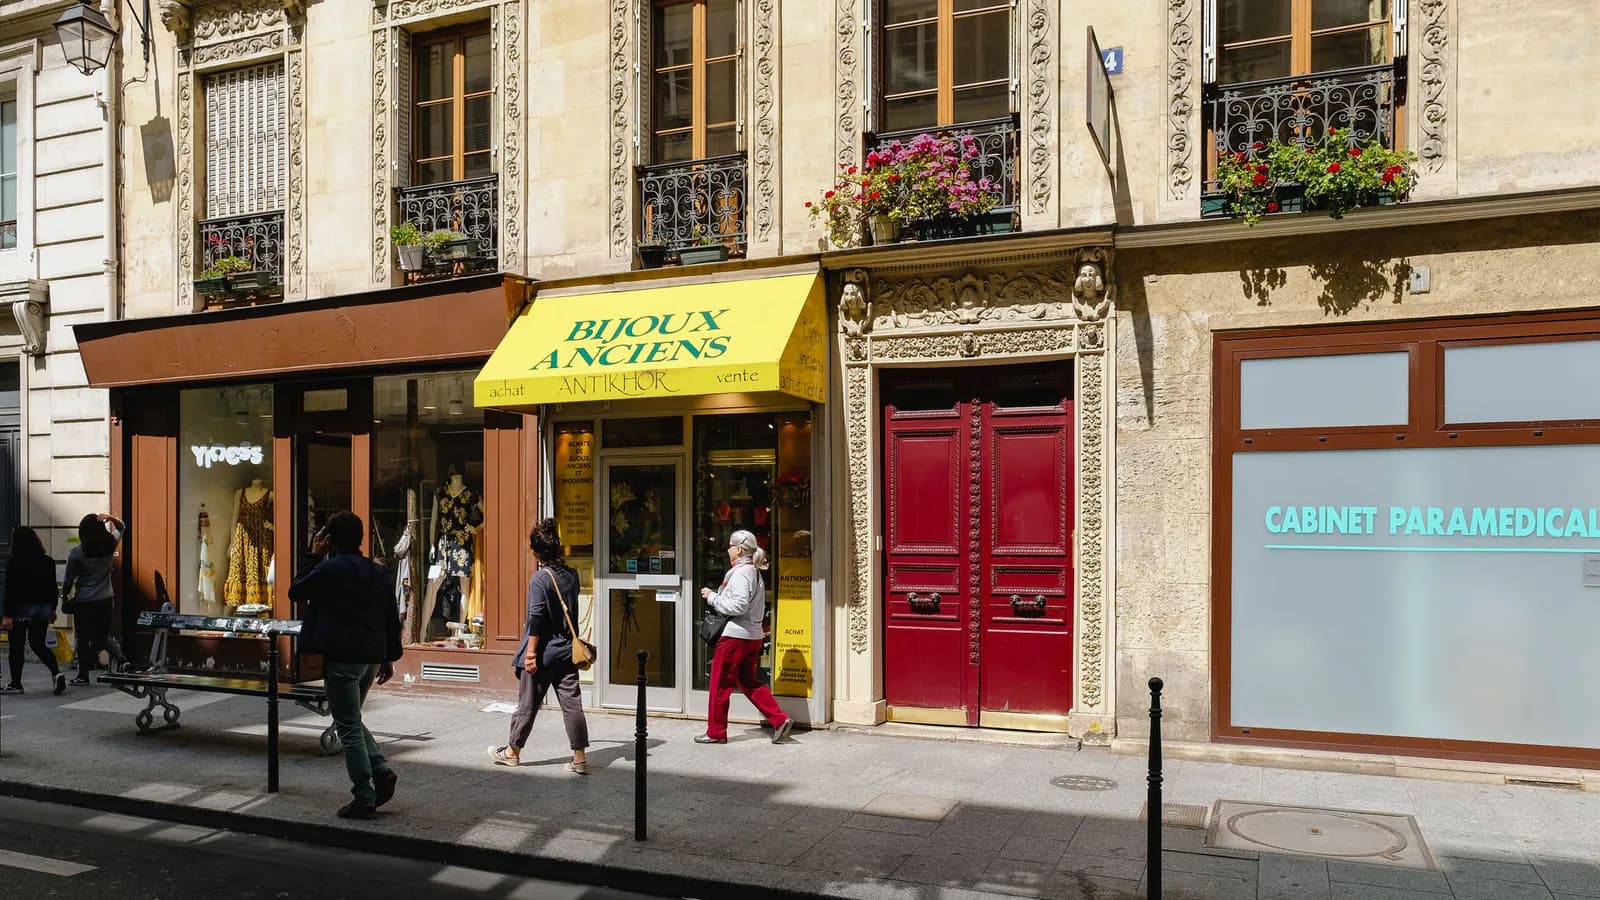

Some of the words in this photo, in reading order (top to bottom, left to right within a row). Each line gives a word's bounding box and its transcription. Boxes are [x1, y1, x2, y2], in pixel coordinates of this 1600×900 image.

[1104, 51, 1117, 71] 4
[563, 308, 731, 344] BIJOUX
[527, 336, 732, 371] ANCIENS
[489, 380, 526, 399] achat
[557, 371, 681, 397] ANTIKHOR
[716, 368, 760, 384] vente
[1265, 506, 1377, 534] CABINET
[1390, 506, 1600, 538] PARAMEDICAL
